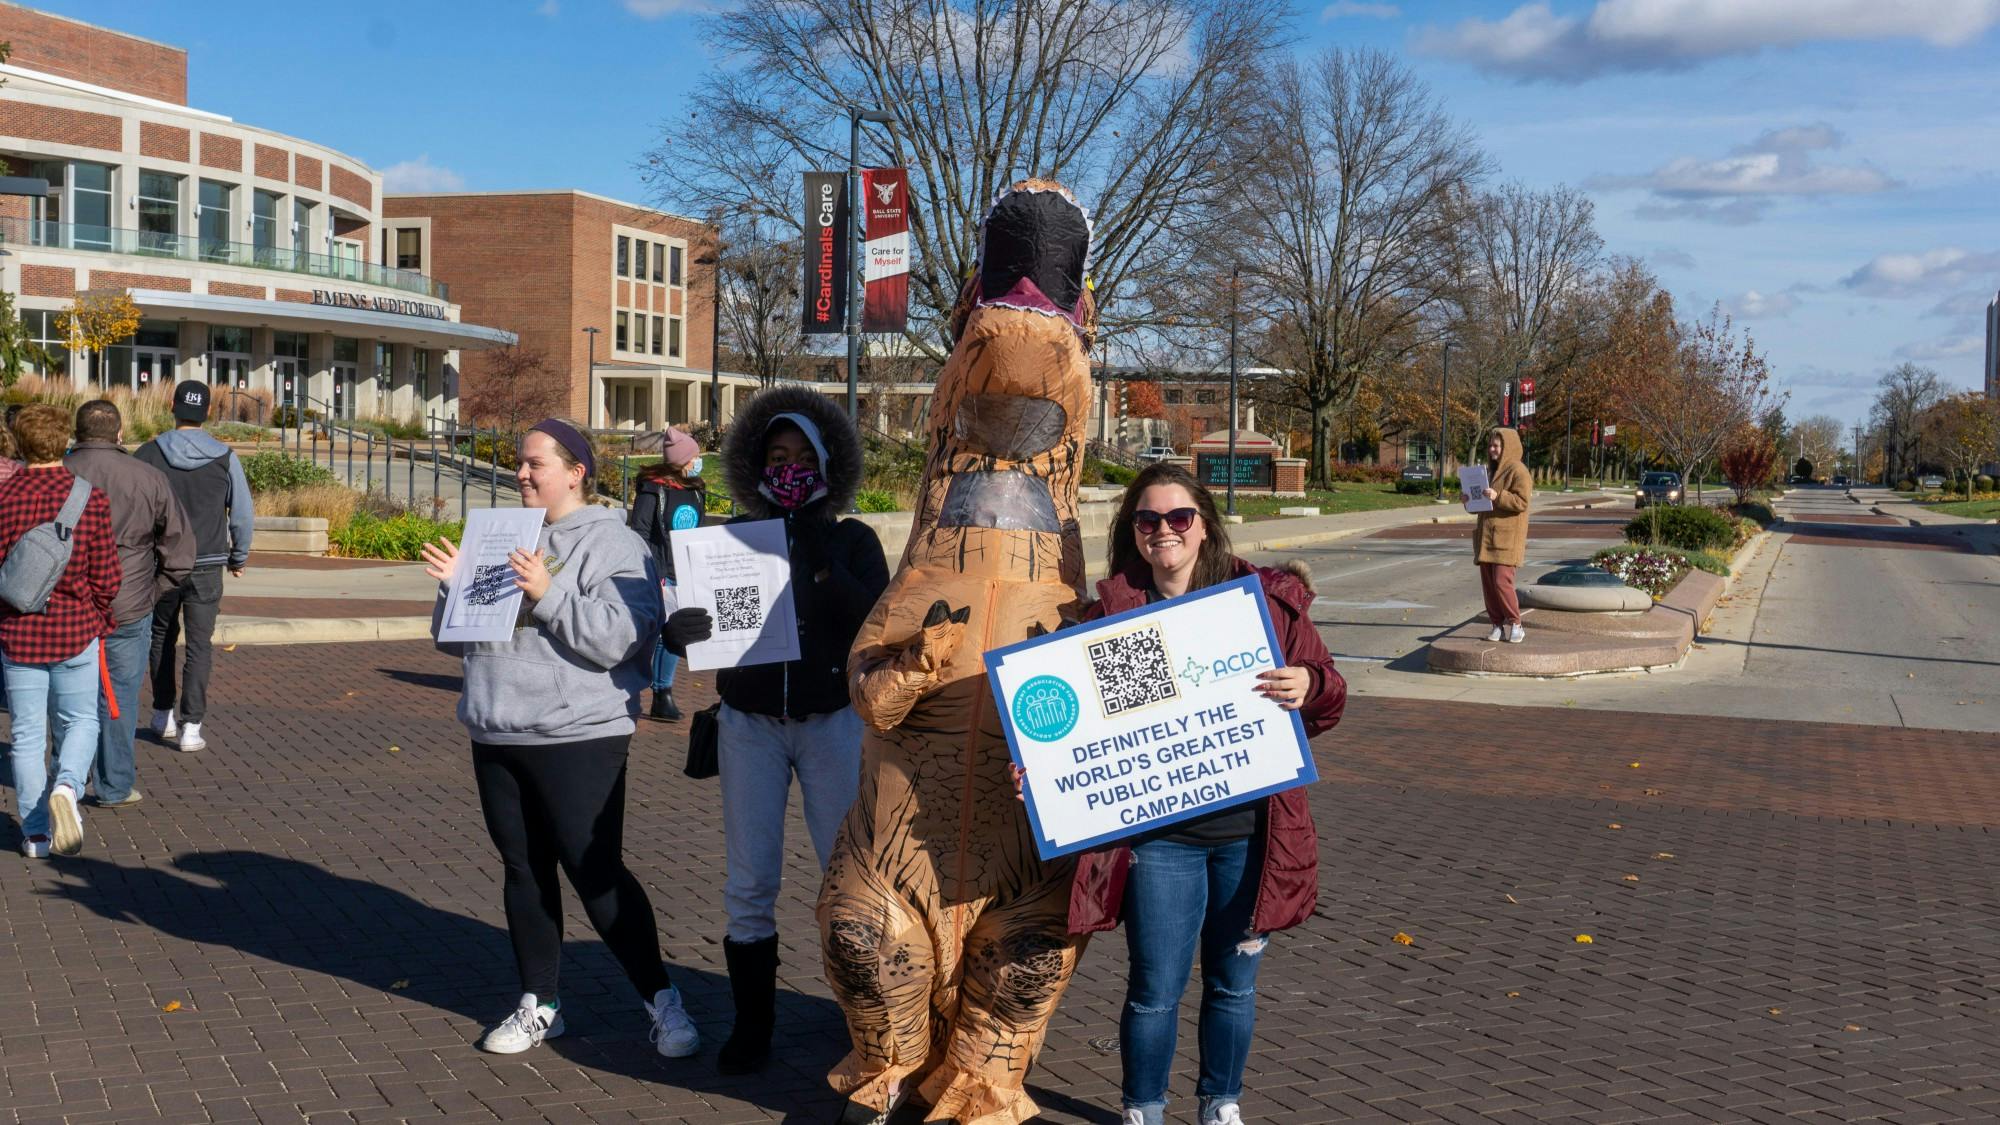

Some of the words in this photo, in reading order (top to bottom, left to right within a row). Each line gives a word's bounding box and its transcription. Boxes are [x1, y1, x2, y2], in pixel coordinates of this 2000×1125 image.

[817, 183, 834, 323] #CardinalsCare
[871, 247, 891, 256] Care
[893, 247, 905, 255] for
[874, 257, 902, 267] Myself
[312, 288, 367, 310] EMENS
[371, 296, 445, 320] AUDITORIUM
[1212, 646, 1271, 677] ACDC
[1072, 715, 1189, 764] DEFINITELY
[1194, 702, 1238, 728] THE
[1055, 753, 1152, 794] WORLD'S
[1156, 719, 1266, 764] GREATEST
[1086, 775, 1162, 810] PUBLIC
[1167, 749, 1250, 787] HEALTH
[1120, 780, 1231, 825] CAMPAIGN
